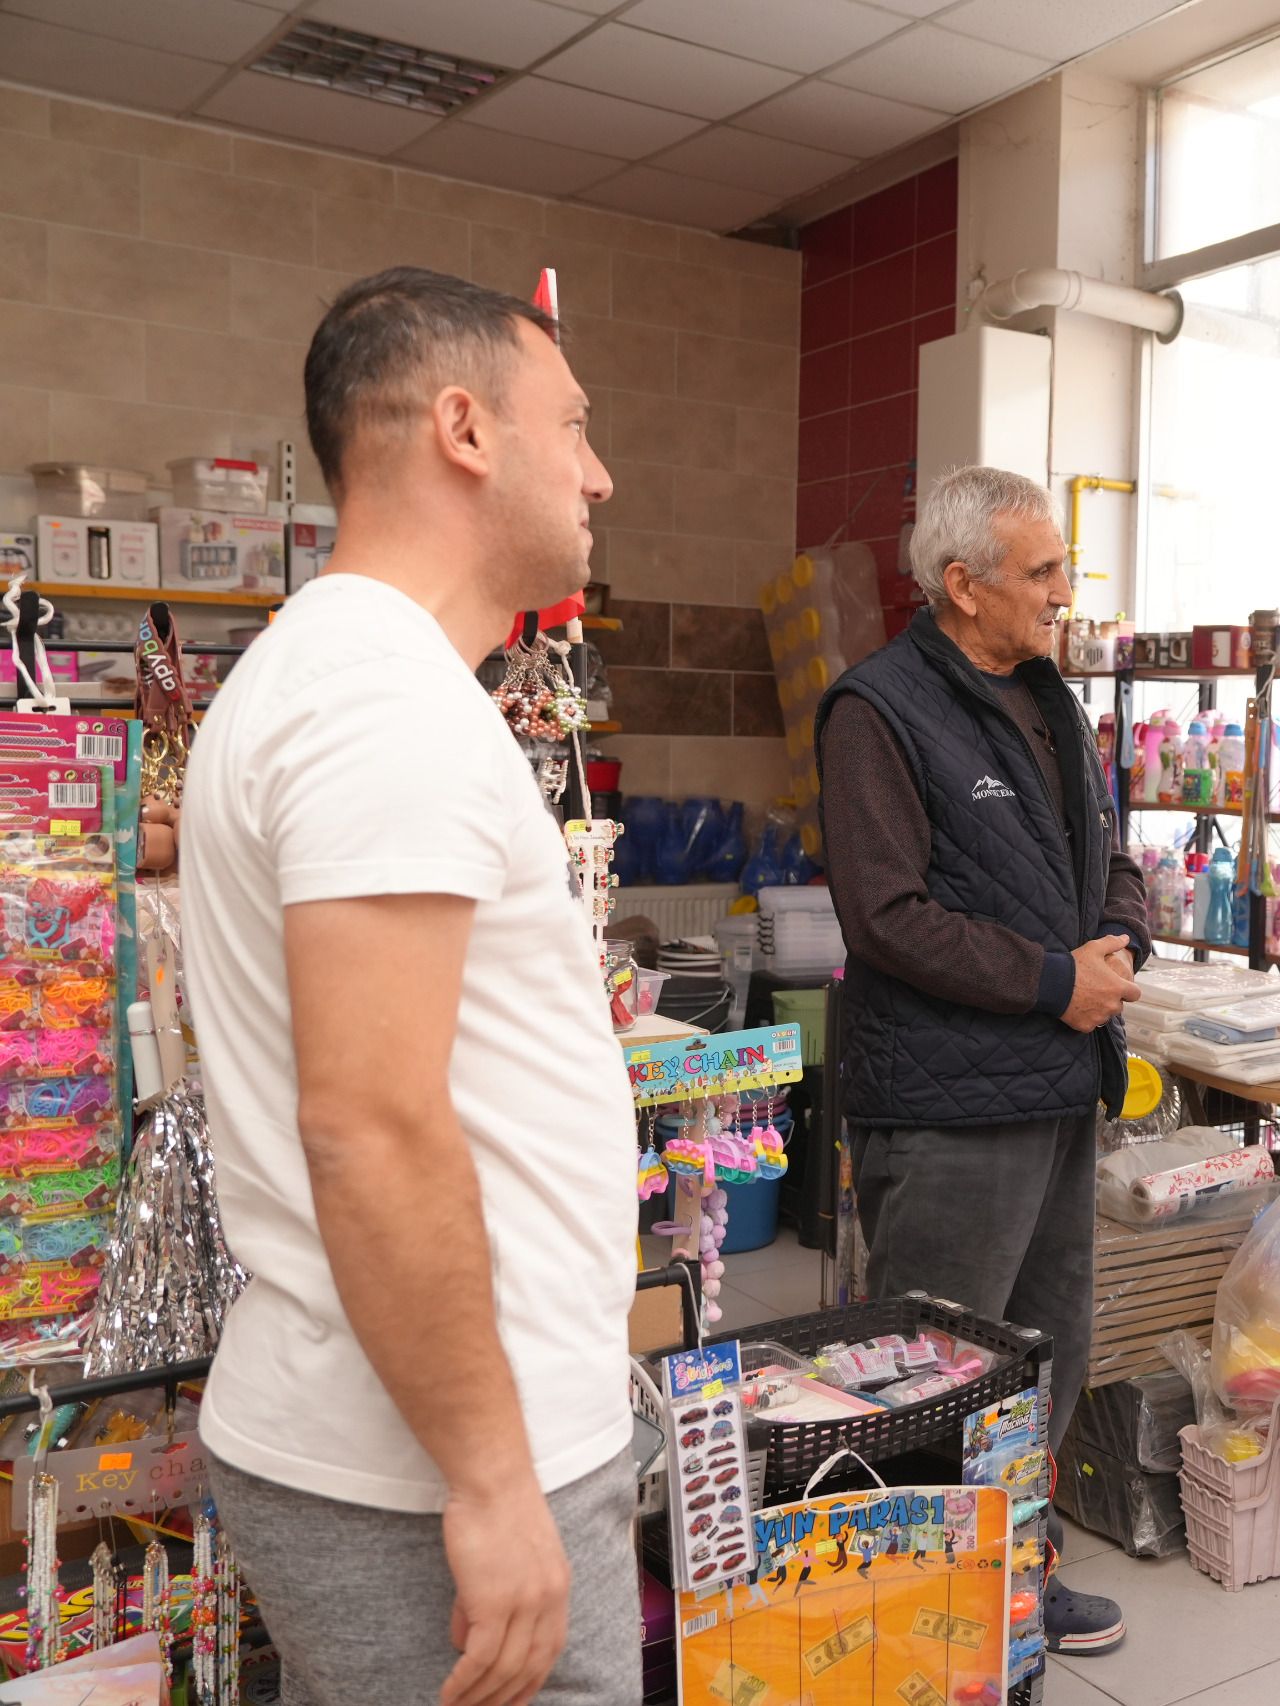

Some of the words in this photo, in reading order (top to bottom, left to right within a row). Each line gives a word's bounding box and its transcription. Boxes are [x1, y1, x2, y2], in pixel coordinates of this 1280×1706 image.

[140, 613, 180, 699] capybar
[627, 1056, 680, 1085] KEY
[683, 1044, 766, 1075] CHAIN
[75, 1470, 138, 1493] Key
[150, 1457, 207, 1480] cha
[754, 1511, 816, 1553] YUN
[828, 1494, 945, 1537] PARASI
